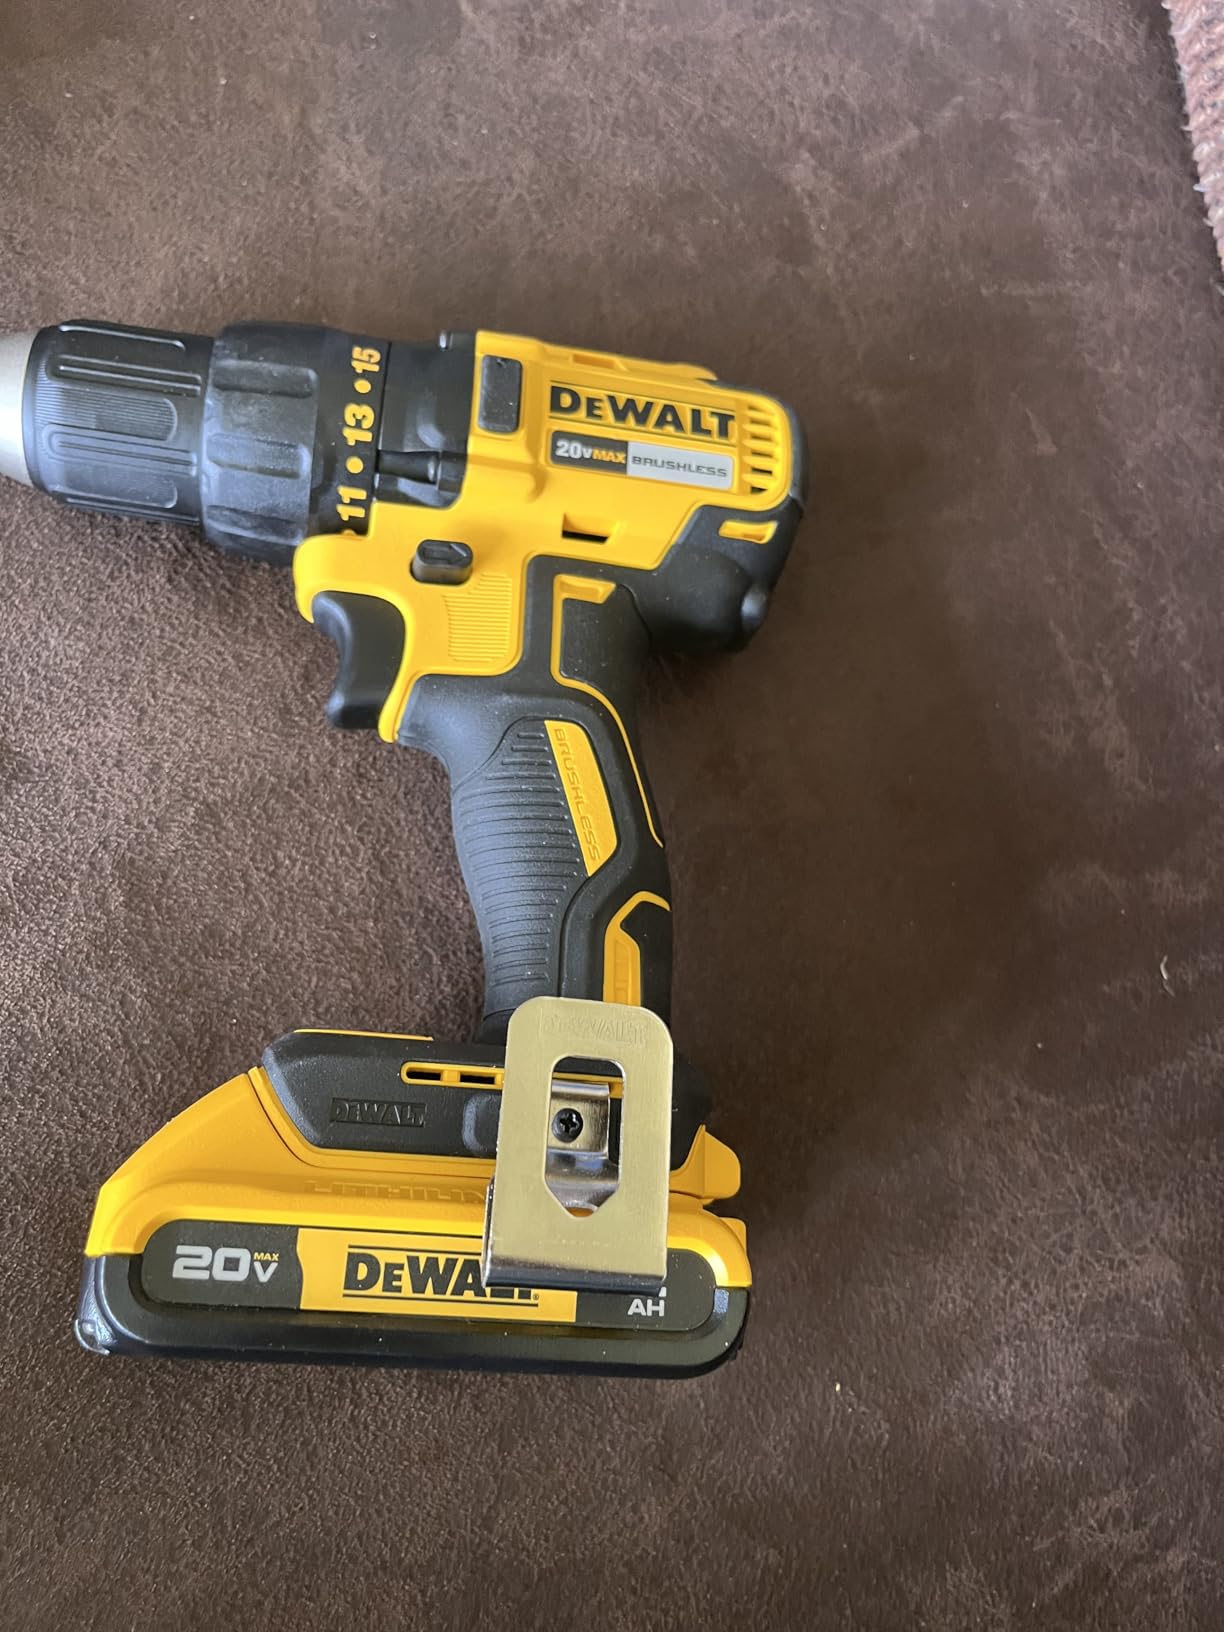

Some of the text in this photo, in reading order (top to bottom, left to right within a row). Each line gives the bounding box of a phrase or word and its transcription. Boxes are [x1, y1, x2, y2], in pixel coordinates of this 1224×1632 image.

[336, 346, 381, 521] 11 13 15
[632, 455, 728, 478] BRUSHLESS
[554, 728, 600, 861] BRUSHLESS
[253, 1251, 280, 1262] MAX
[627, 1298, 665, 1317] AH
